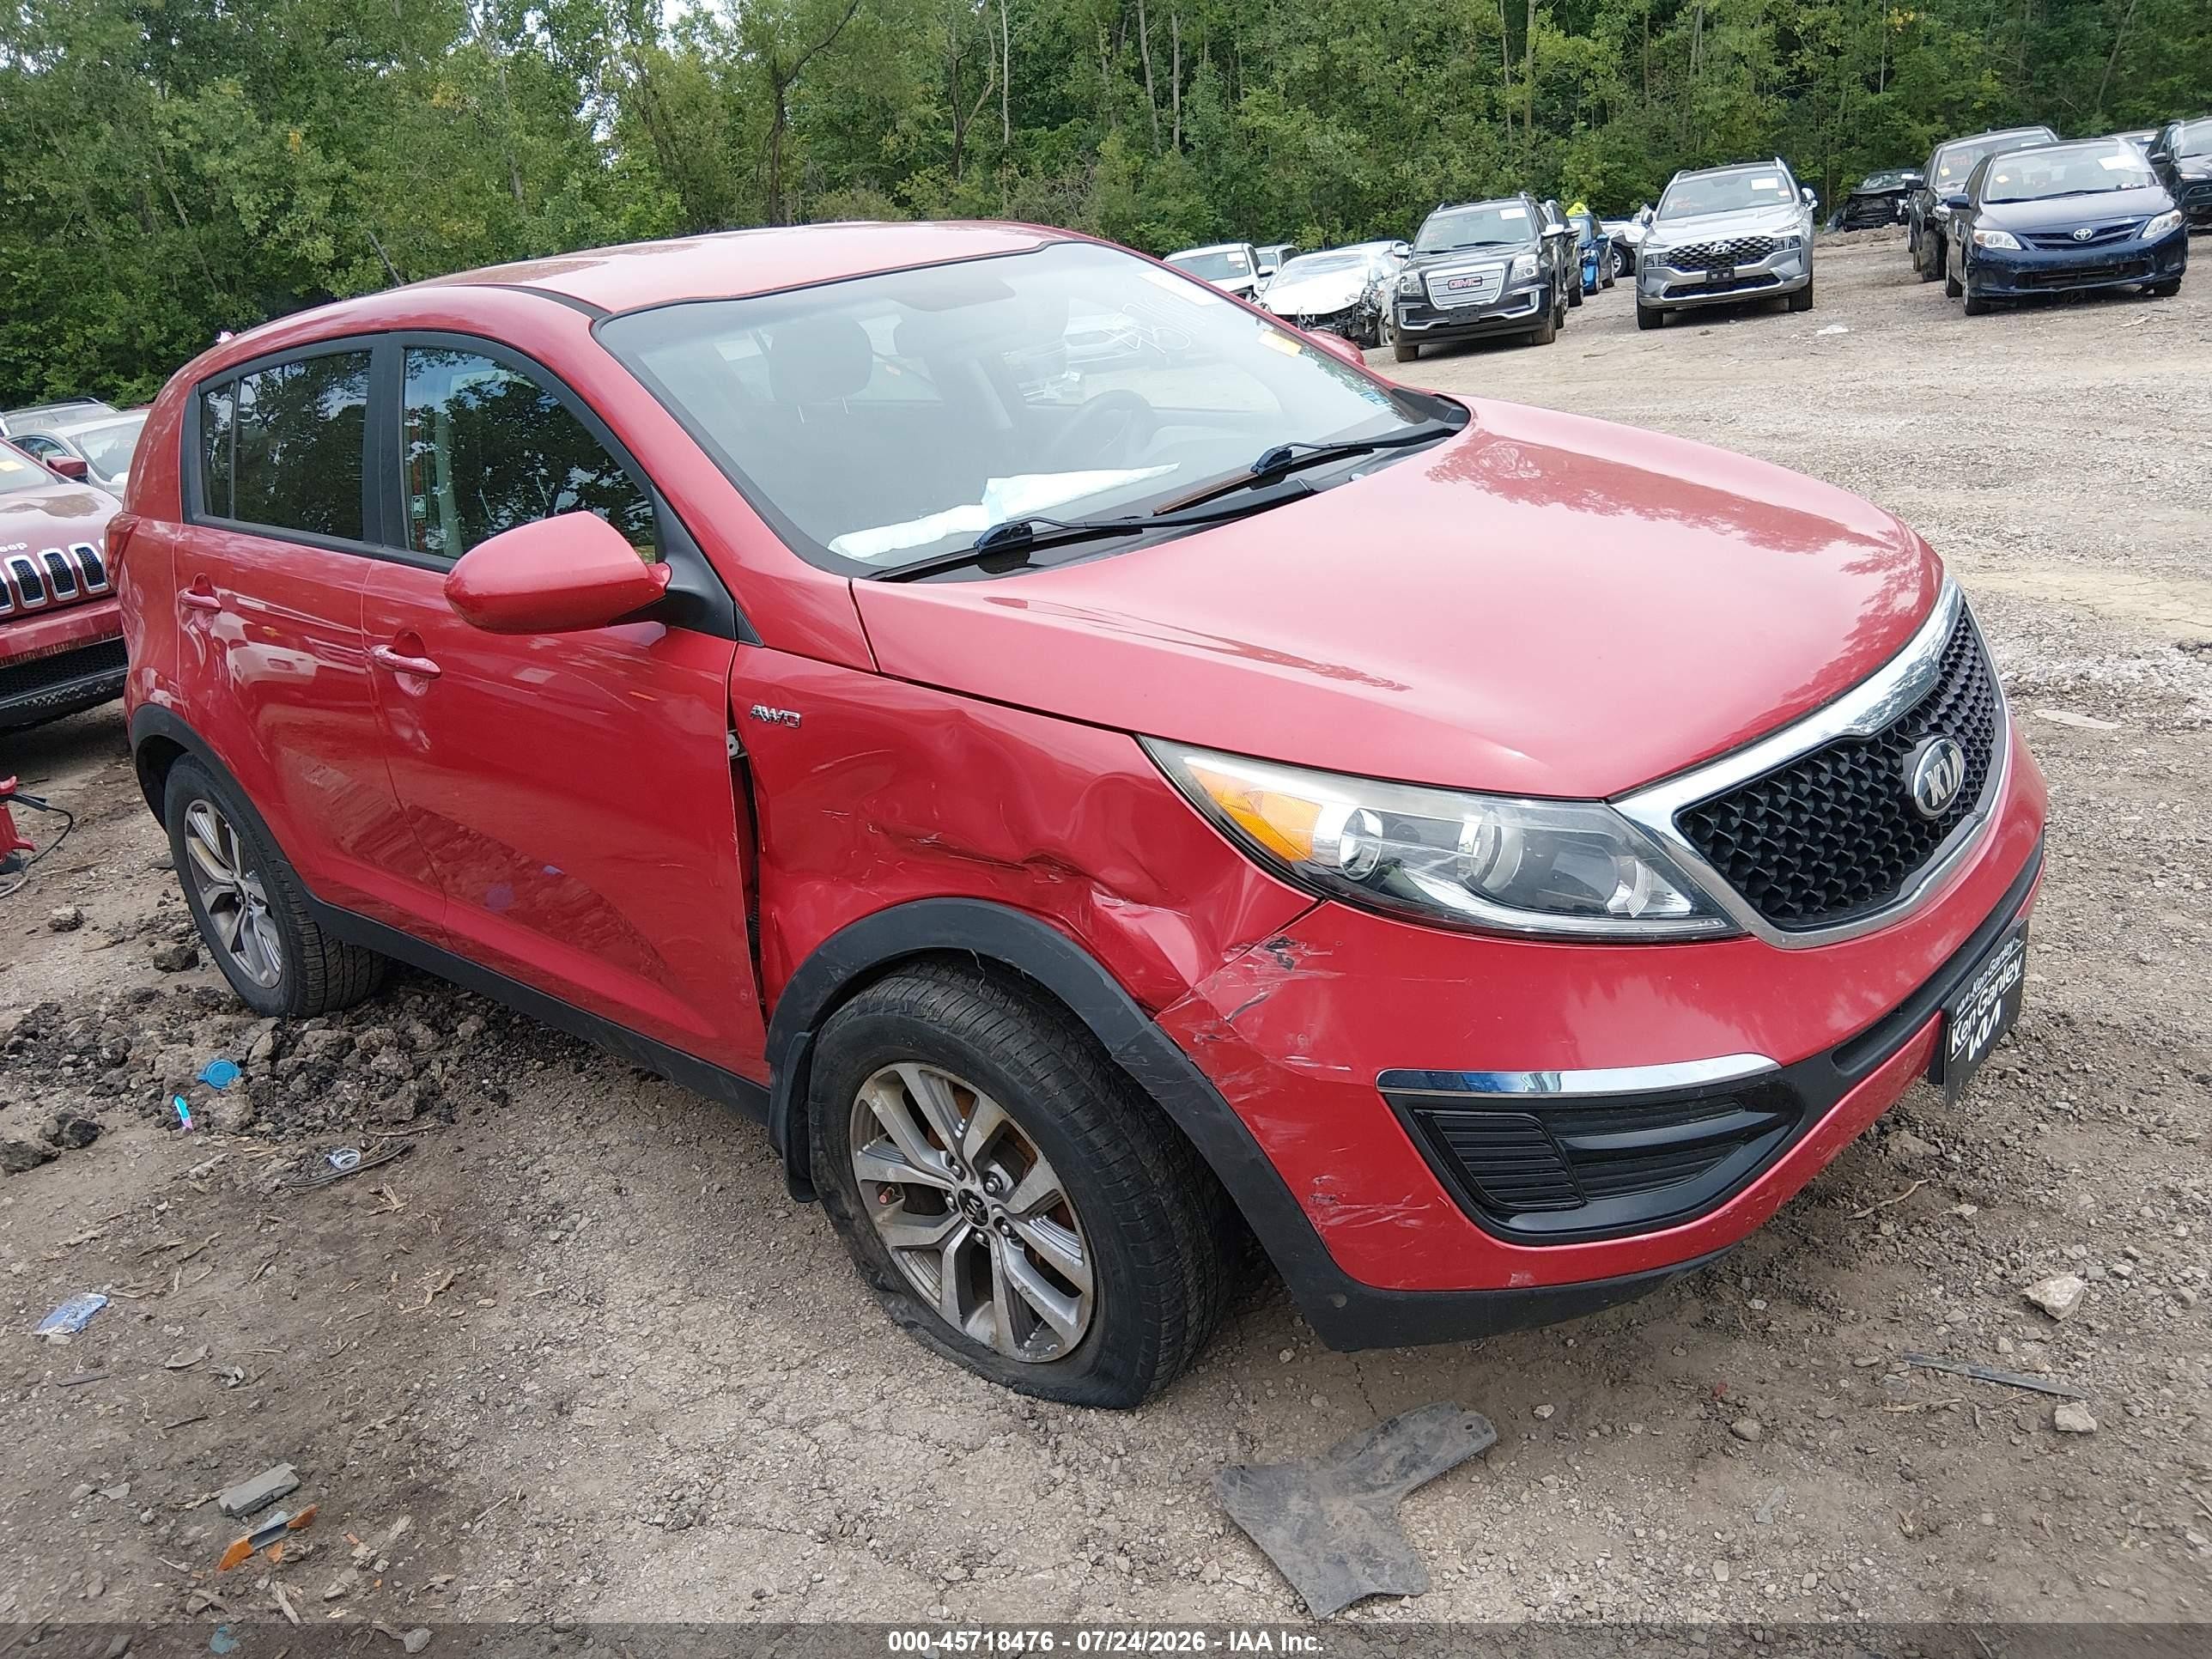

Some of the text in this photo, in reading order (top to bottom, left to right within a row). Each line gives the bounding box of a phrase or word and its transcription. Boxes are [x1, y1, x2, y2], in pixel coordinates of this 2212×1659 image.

[1449, 277, 1482, 289] GMC
[0, 542, 27, 552] eep
[750, 704, 802, 728] AWD
[1924, 750, 1962, 807] KIA
[1951, 952, 2023, 1055] Ken Ganley
